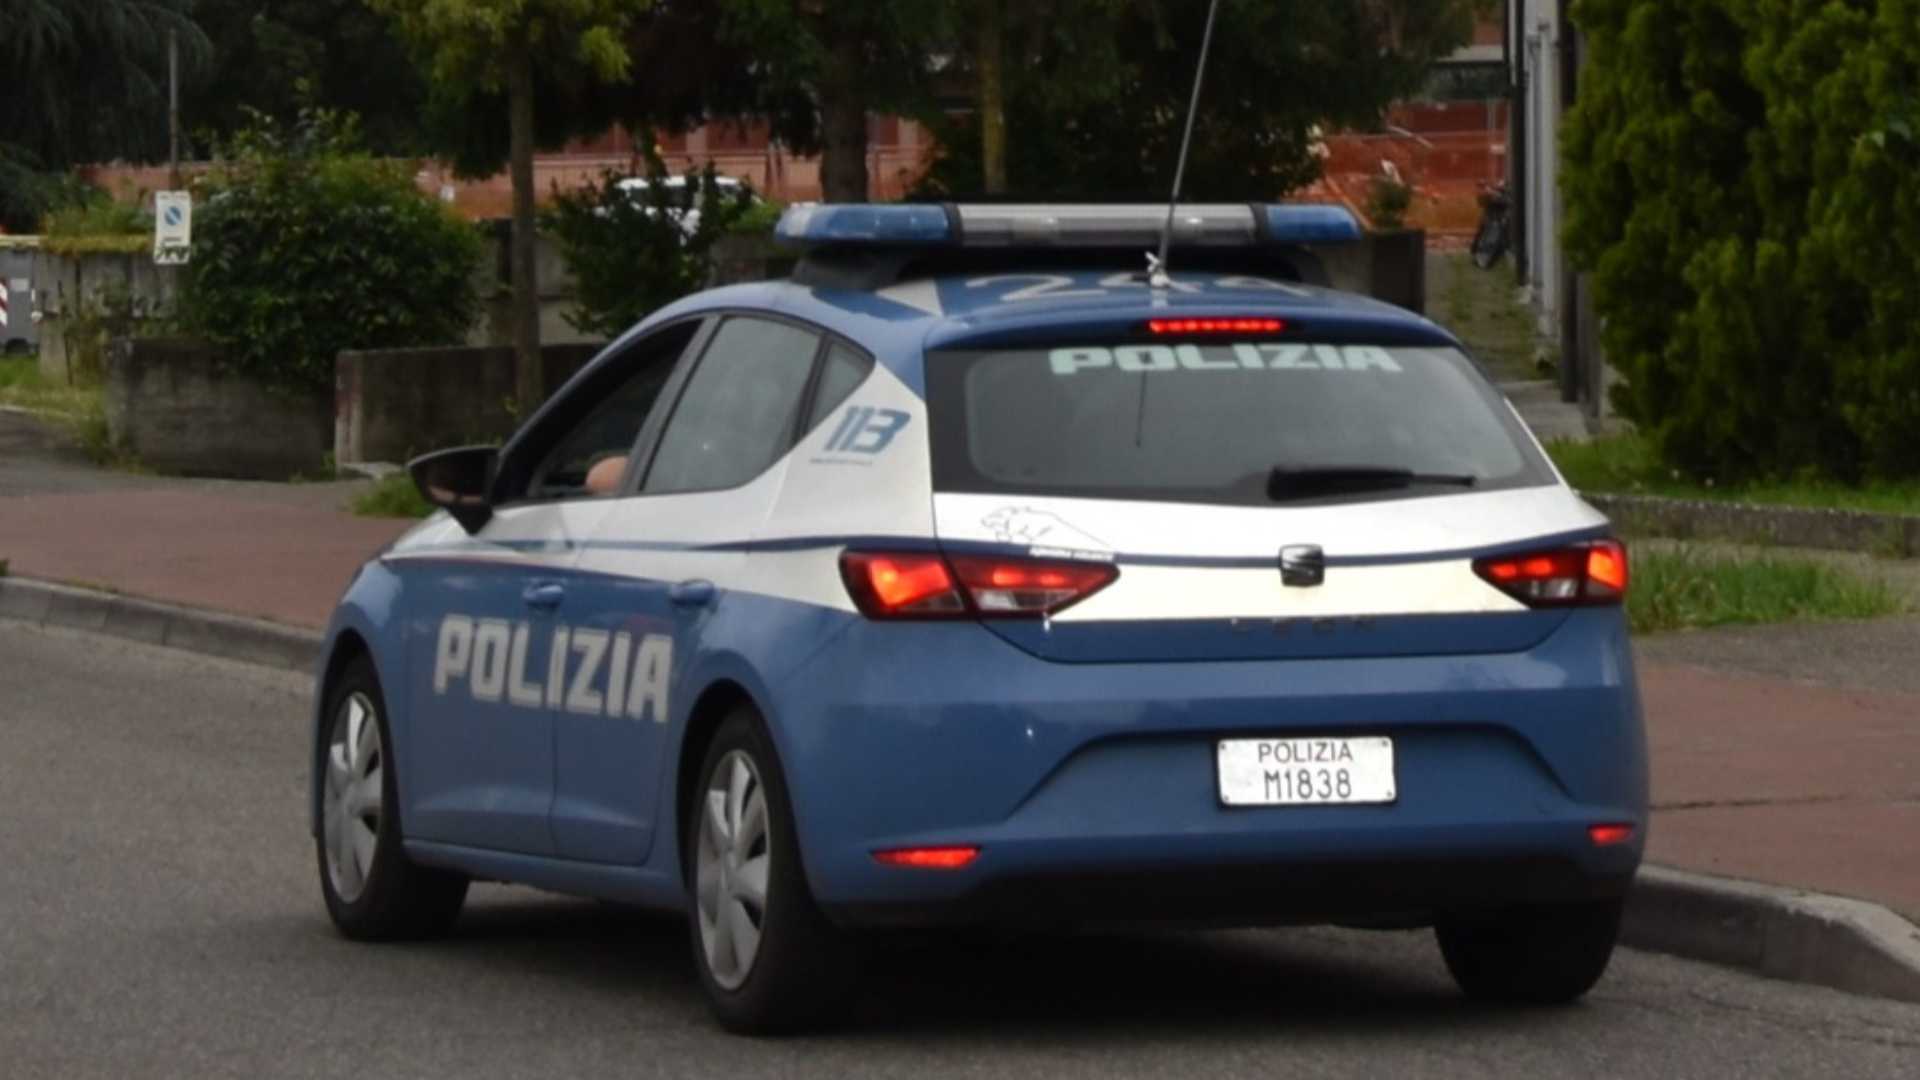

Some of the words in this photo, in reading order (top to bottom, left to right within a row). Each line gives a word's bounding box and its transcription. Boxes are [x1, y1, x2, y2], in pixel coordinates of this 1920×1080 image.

[1049, 343, 1403, 375] POLIZIA
[824, 406, 911, 455] 113
[433, 613, 674, 723] POLIZIA
[1258, 742, 1353, 763] POLIZIA
[1264, 769, 1351, 799] M1838
